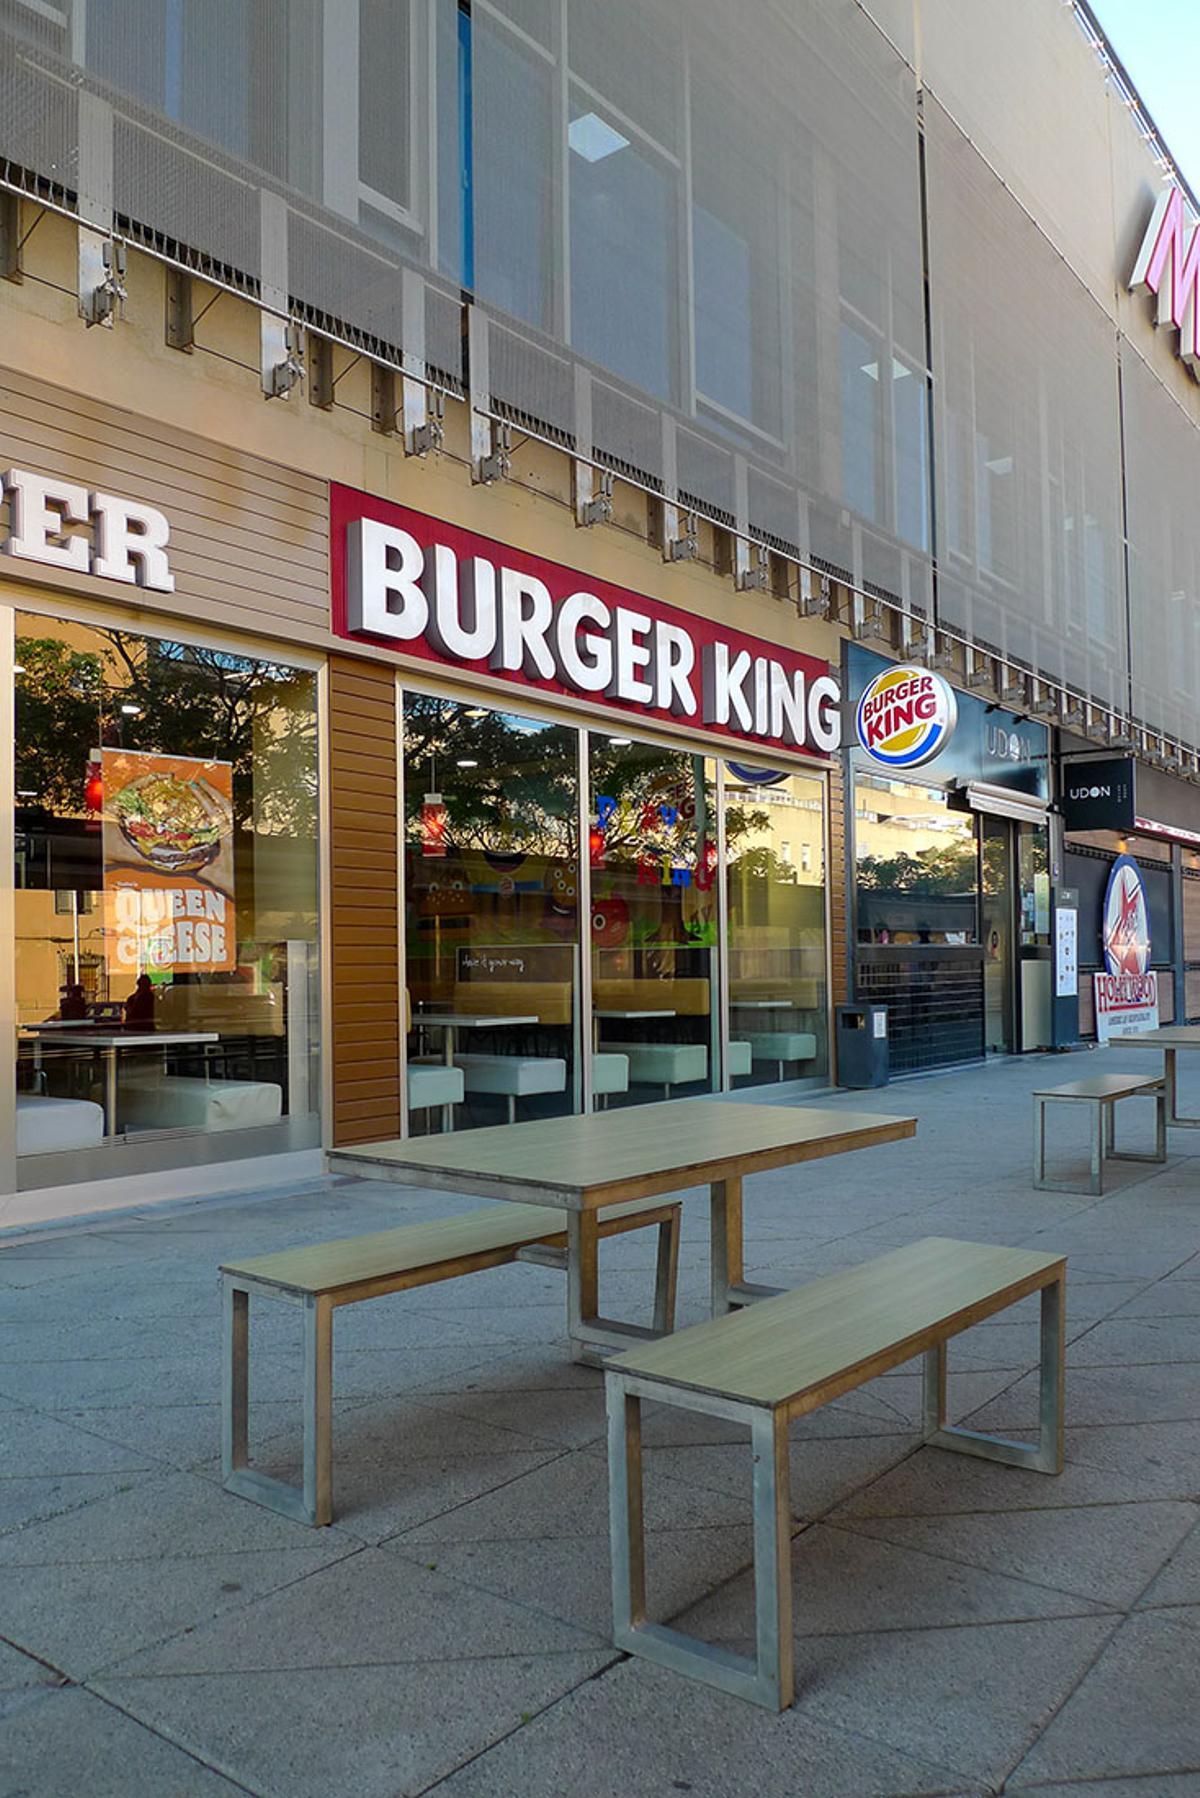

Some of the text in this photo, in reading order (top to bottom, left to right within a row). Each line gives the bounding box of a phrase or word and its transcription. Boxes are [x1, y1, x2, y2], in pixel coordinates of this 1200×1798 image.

[0, 468, 175, 593] ER
[347, 518, 841, 752] BURGER KING
[864, 677, 933, 722] BURGER
[867, 693, 936, 748] KING
[1069, 785, 1111, 800] UDON
[115, 888, 226, 933] QUEEN
